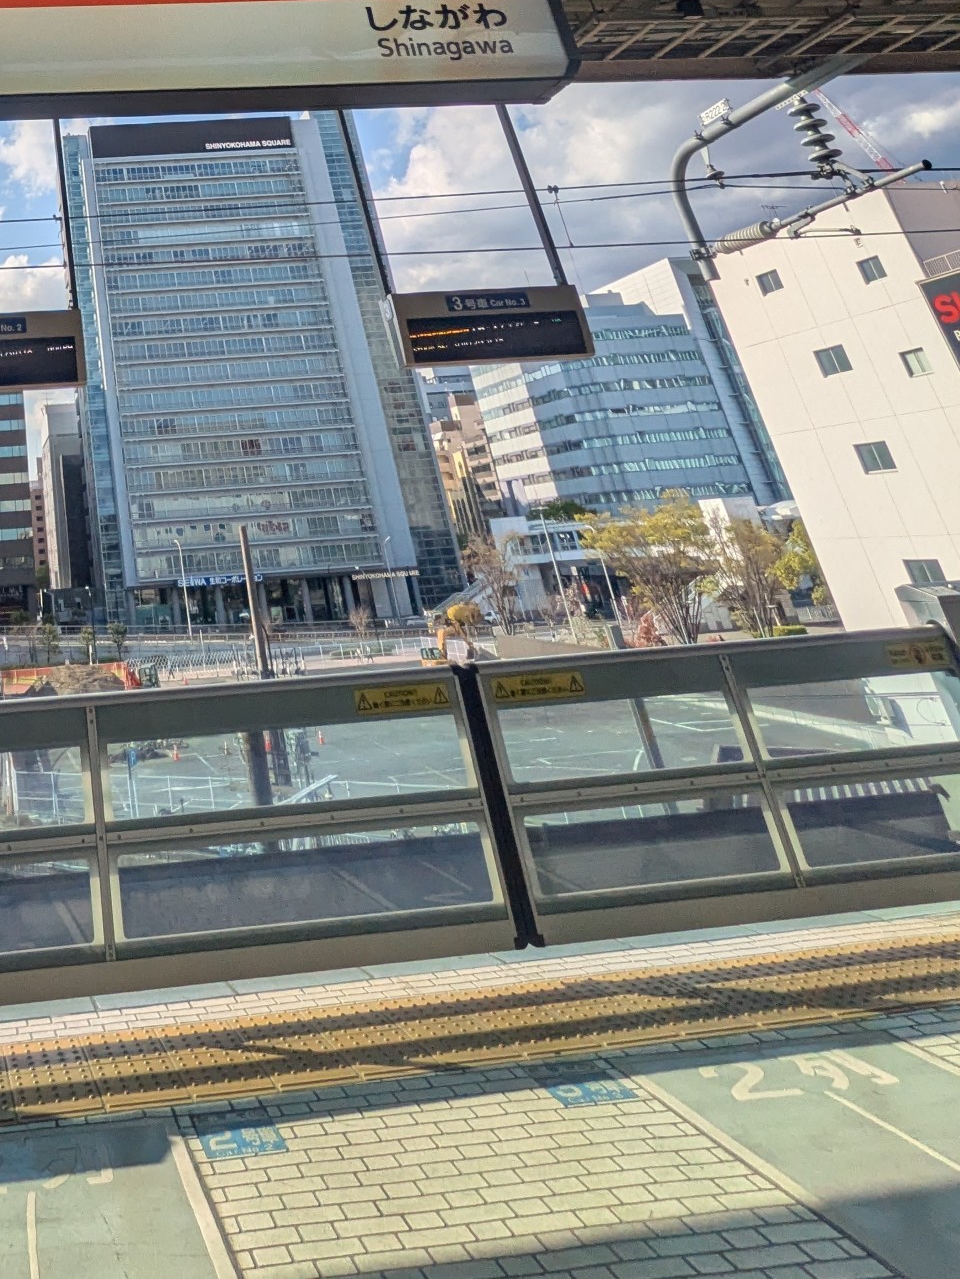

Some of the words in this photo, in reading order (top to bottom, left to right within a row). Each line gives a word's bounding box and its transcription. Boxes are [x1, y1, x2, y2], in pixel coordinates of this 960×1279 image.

[365, 3, 508, 31] しながわ
[378, 36, 514, 60] Shinagawa
[205, 141, 260, 150] SHINYOKOHAMA
[262, 139, 291, 148] SQUARE
[490, 299, 505, 308] Car
[698, 1048, 900, 1101] 2列
